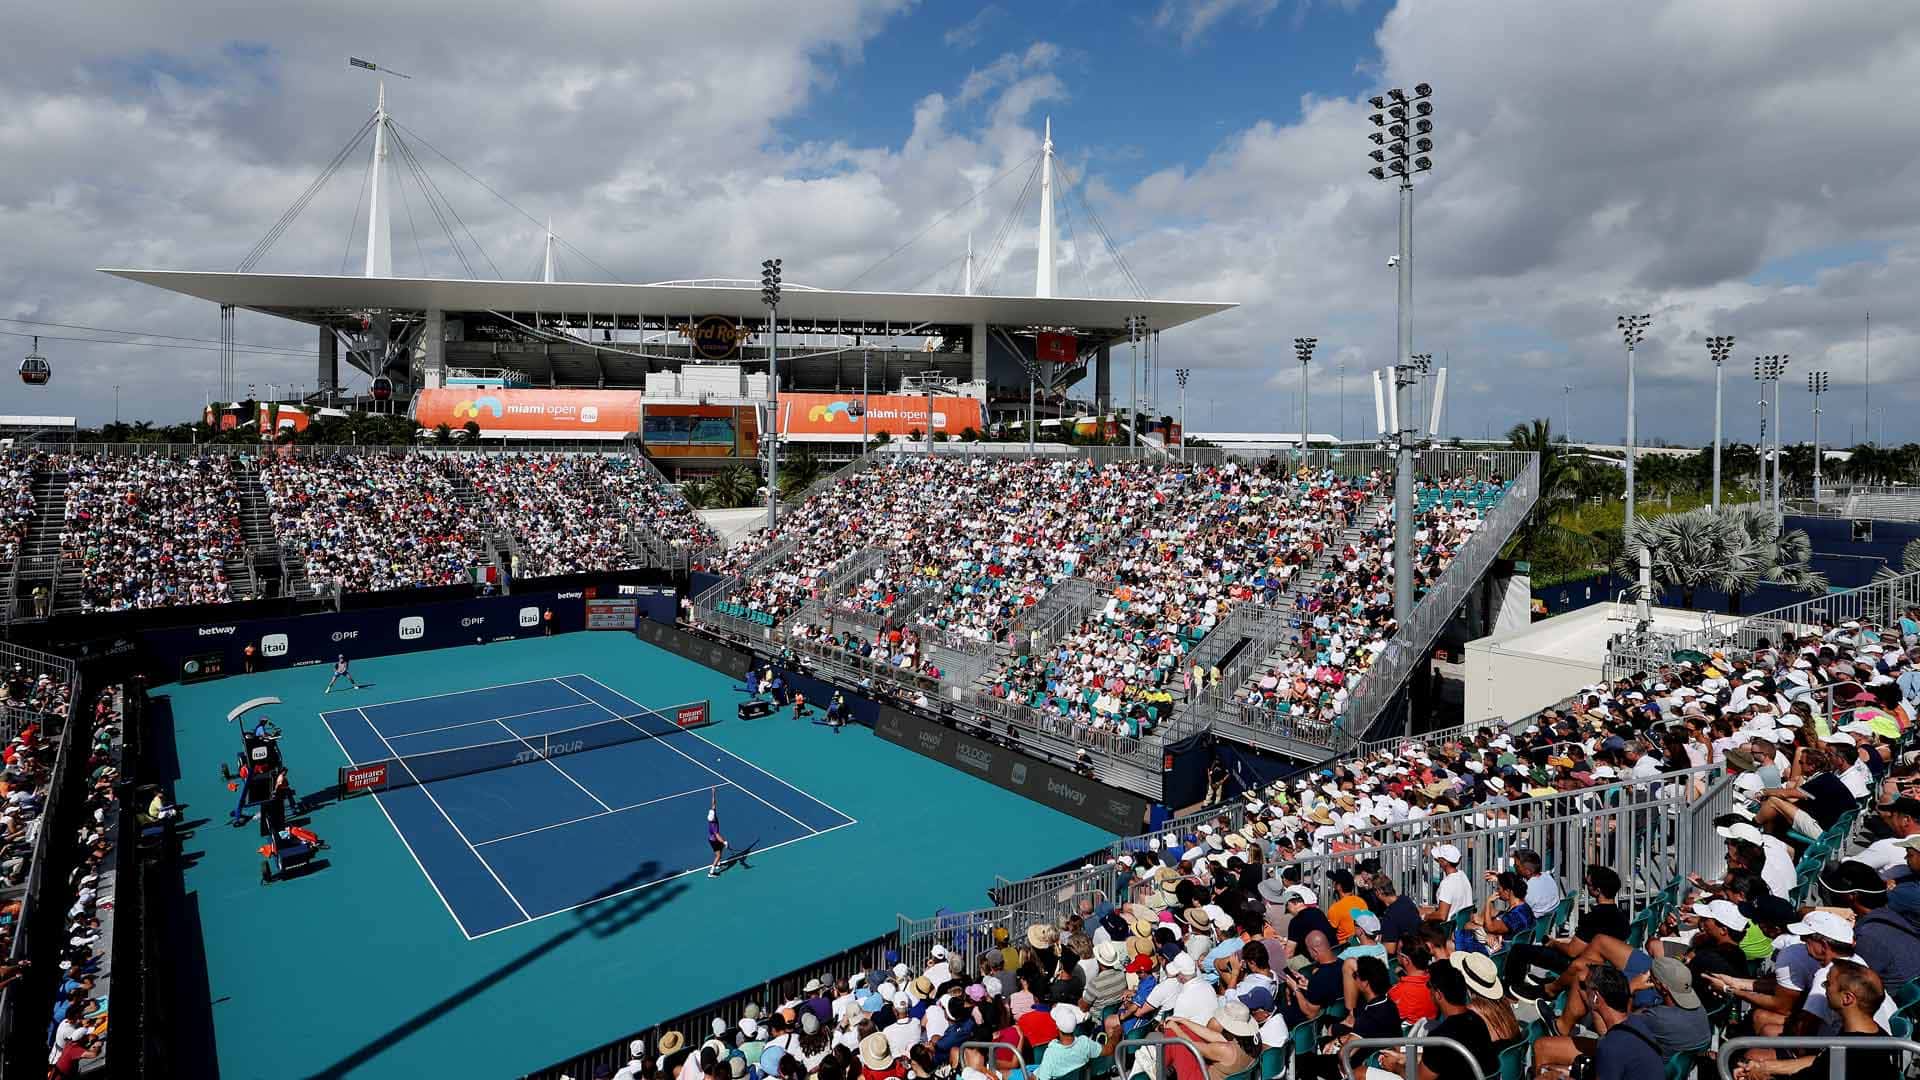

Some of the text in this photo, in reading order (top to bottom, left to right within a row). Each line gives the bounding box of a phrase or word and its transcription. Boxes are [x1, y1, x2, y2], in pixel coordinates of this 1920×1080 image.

[507, 403, 577, 416] miami open
[900, 410, 927, 422] open
[557, 591, 583, 600] betway
[471, 617, 486, 625] PIF
[520, 614, 538, 624] itaú
[198, 625, 236, 636] betway
[343, 631, 359, 640] PIF
[401, 625, 422, 636] itaú
[263, 642, 286, 653] itaú
[548, 740, 584, 756] TOUR
[349, 767, 385, 782] Emirates
[1047, 776, 1087, 806] betway
